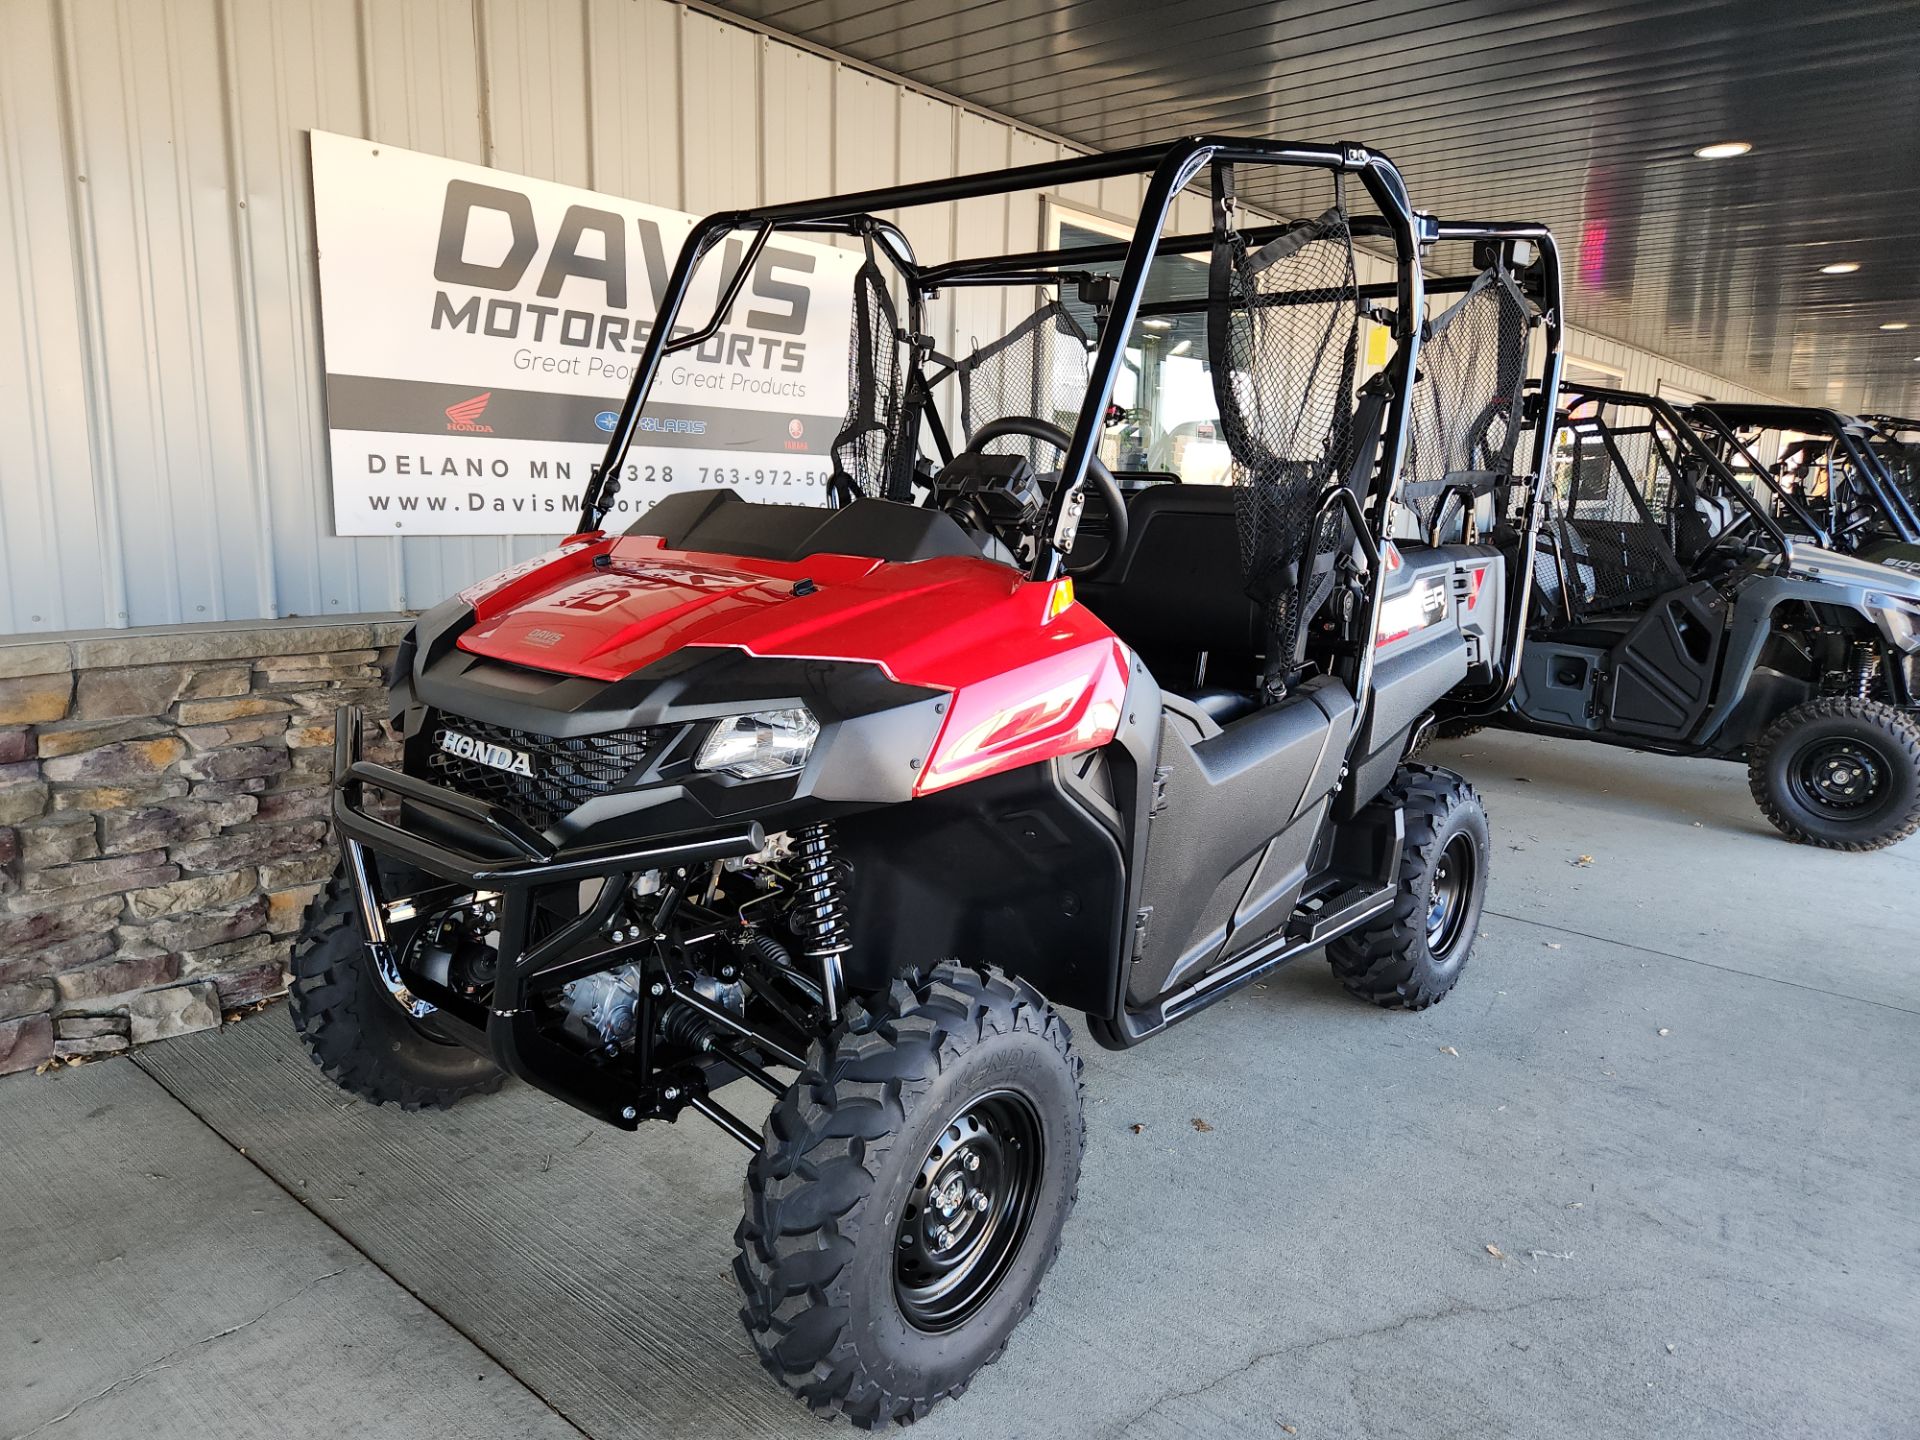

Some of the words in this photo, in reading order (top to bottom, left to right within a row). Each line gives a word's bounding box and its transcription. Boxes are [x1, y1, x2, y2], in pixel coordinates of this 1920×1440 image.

[433, 178, 816, 335] DAVIS
[430, 290, 807, 373] MOTORSPORTS
[513, 348, 580, 376] Great
[588, 356, 663, 387] Peope,
[671, 366, 725, 390] Great
[730, 372, 807, 398] Products
[446, 422, 494, 433] HONDA
[638, 417, 705, 434] OLARIS
[368, 454, 509, 478] DELANO
[530, 461, 571, 480] MN
[591, 464, 673, 482] 328
[440, 730, 537, 779] HONDA
